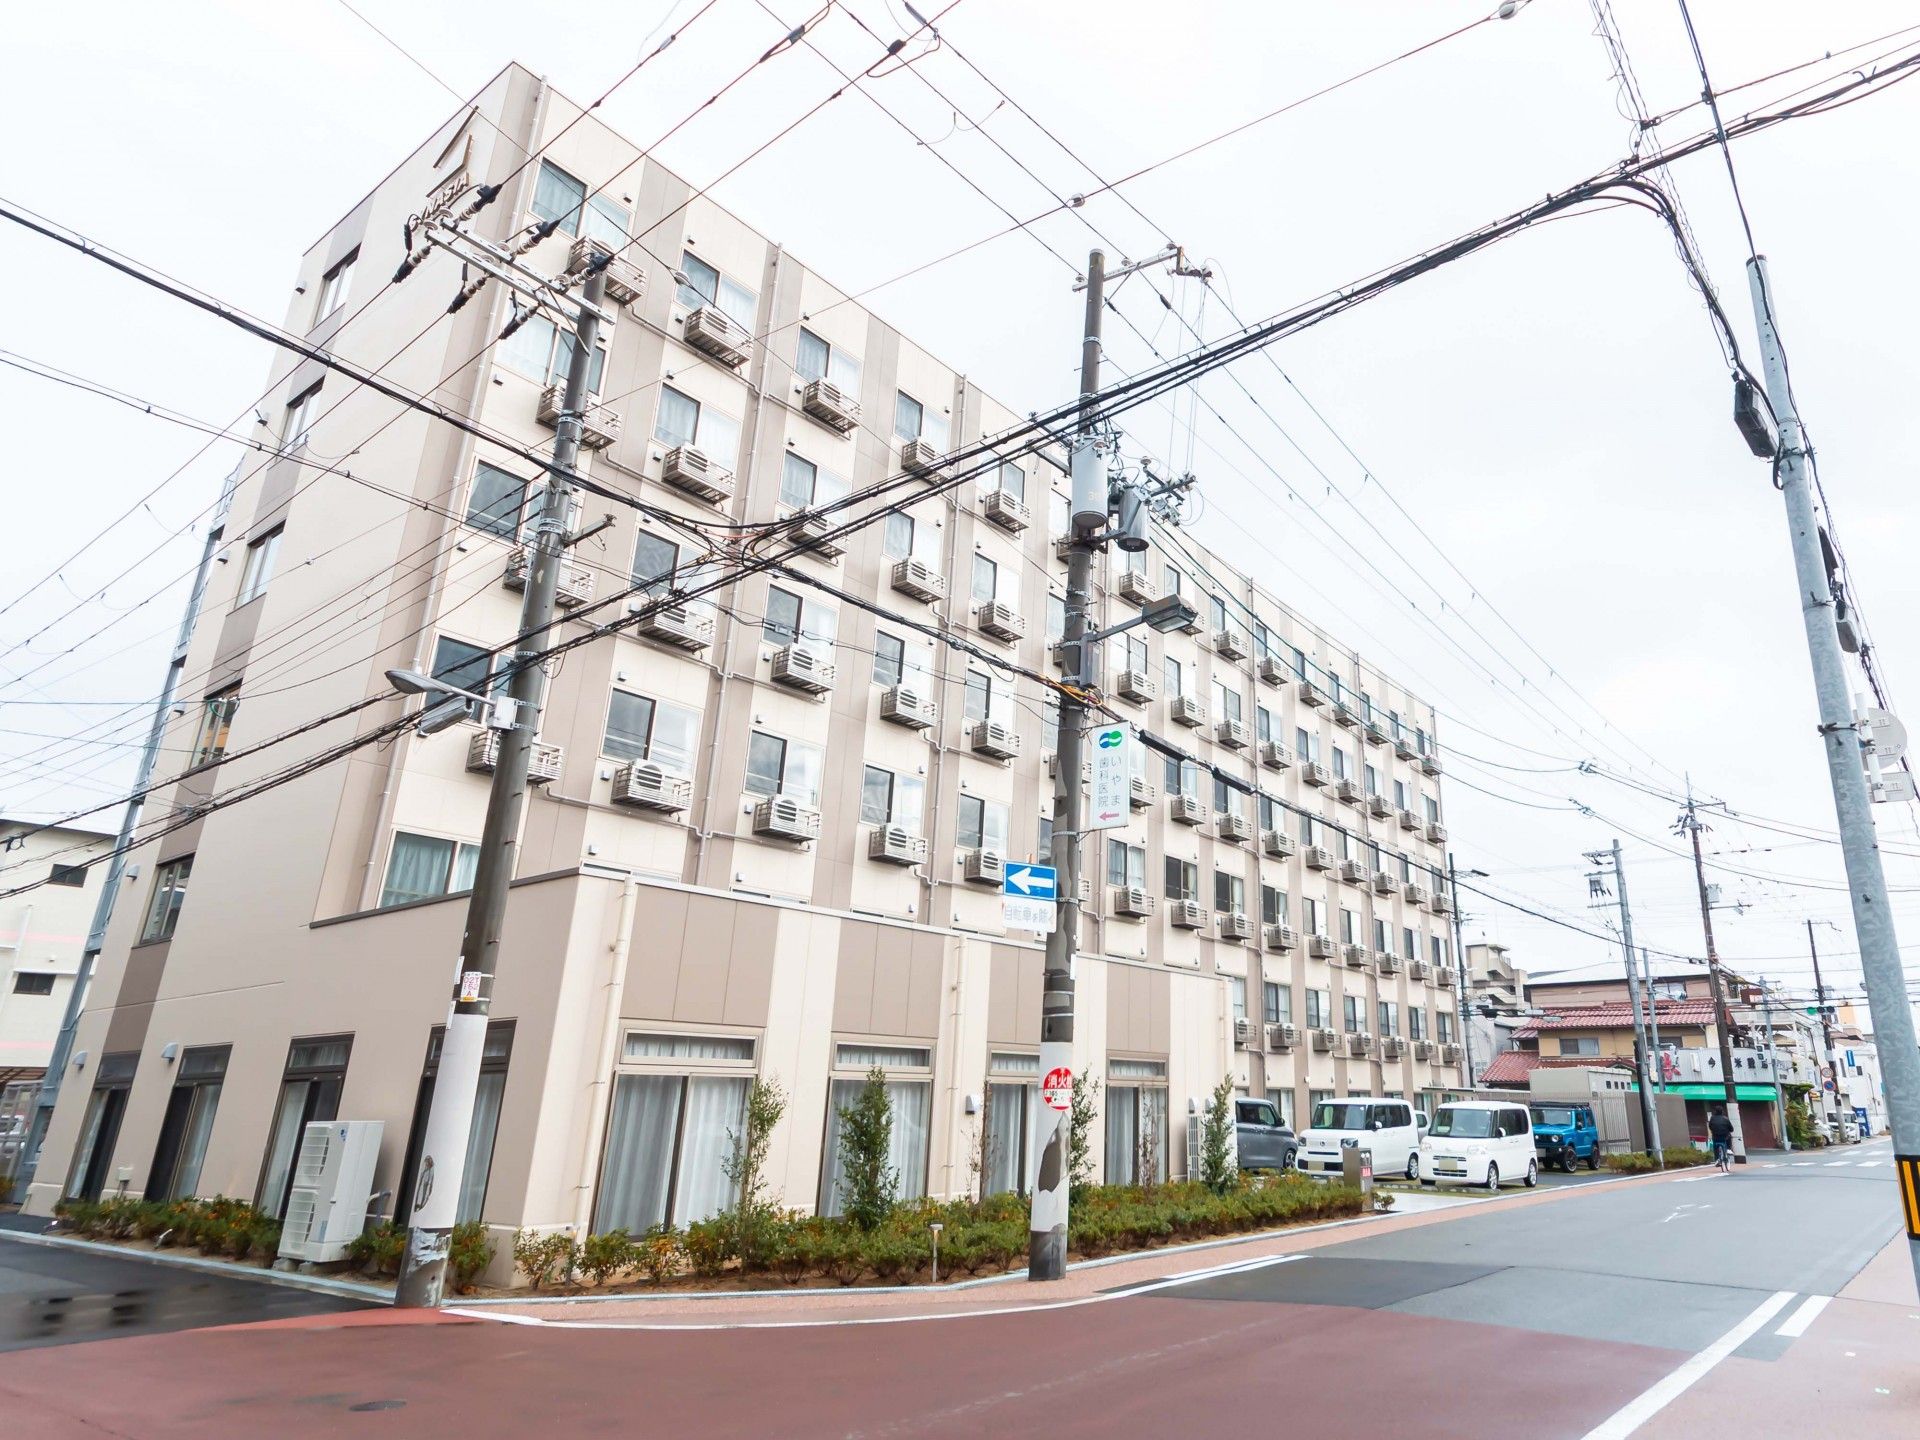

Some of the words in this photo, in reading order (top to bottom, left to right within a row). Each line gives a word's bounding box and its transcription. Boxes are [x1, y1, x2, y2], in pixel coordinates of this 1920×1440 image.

[1098, 757, 1109, 807] 歯科医院
[1110, 756, 1121, 807] いやま
